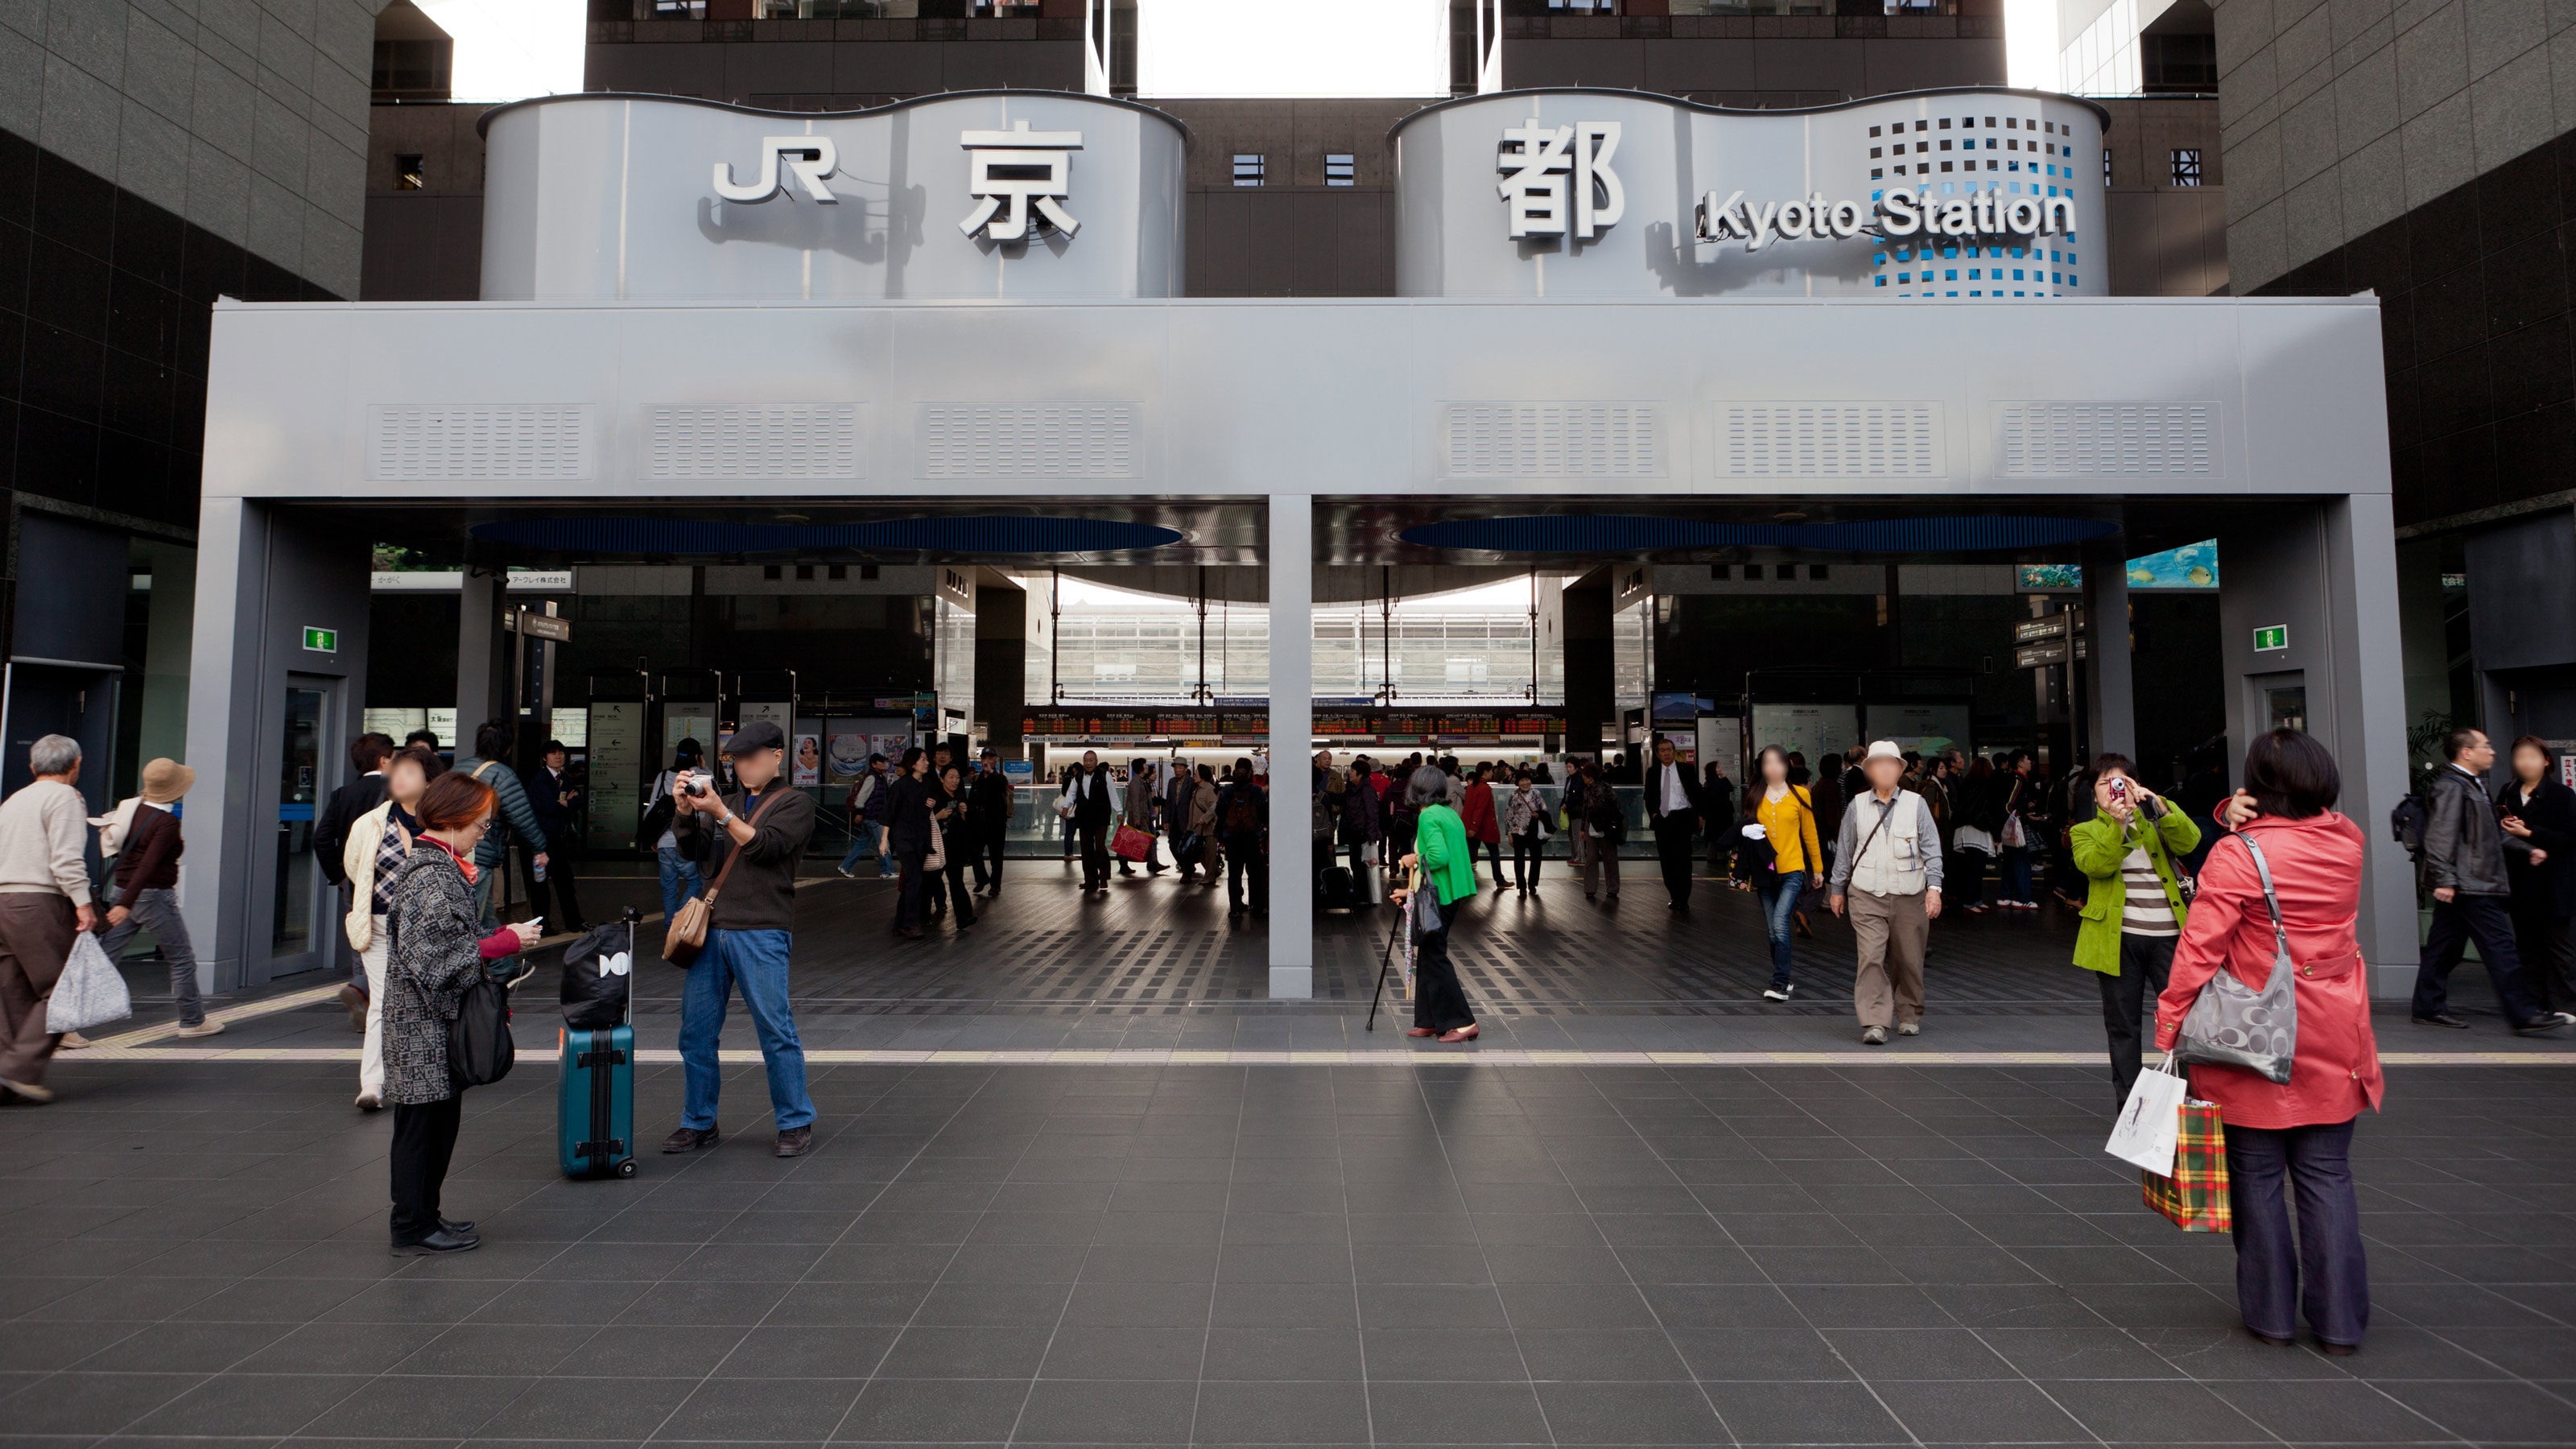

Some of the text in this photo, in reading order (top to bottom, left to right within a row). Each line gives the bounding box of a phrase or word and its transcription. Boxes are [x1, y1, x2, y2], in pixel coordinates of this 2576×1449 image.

[713, 135, 840, 205] JR
[959, 118, 1084, 241] 京
[1497, 118, 1625, 240] 都
[1702, 186, 2077, 251] Kyoto Station
[513, 576, 567, 584] アークレイ株式会社
